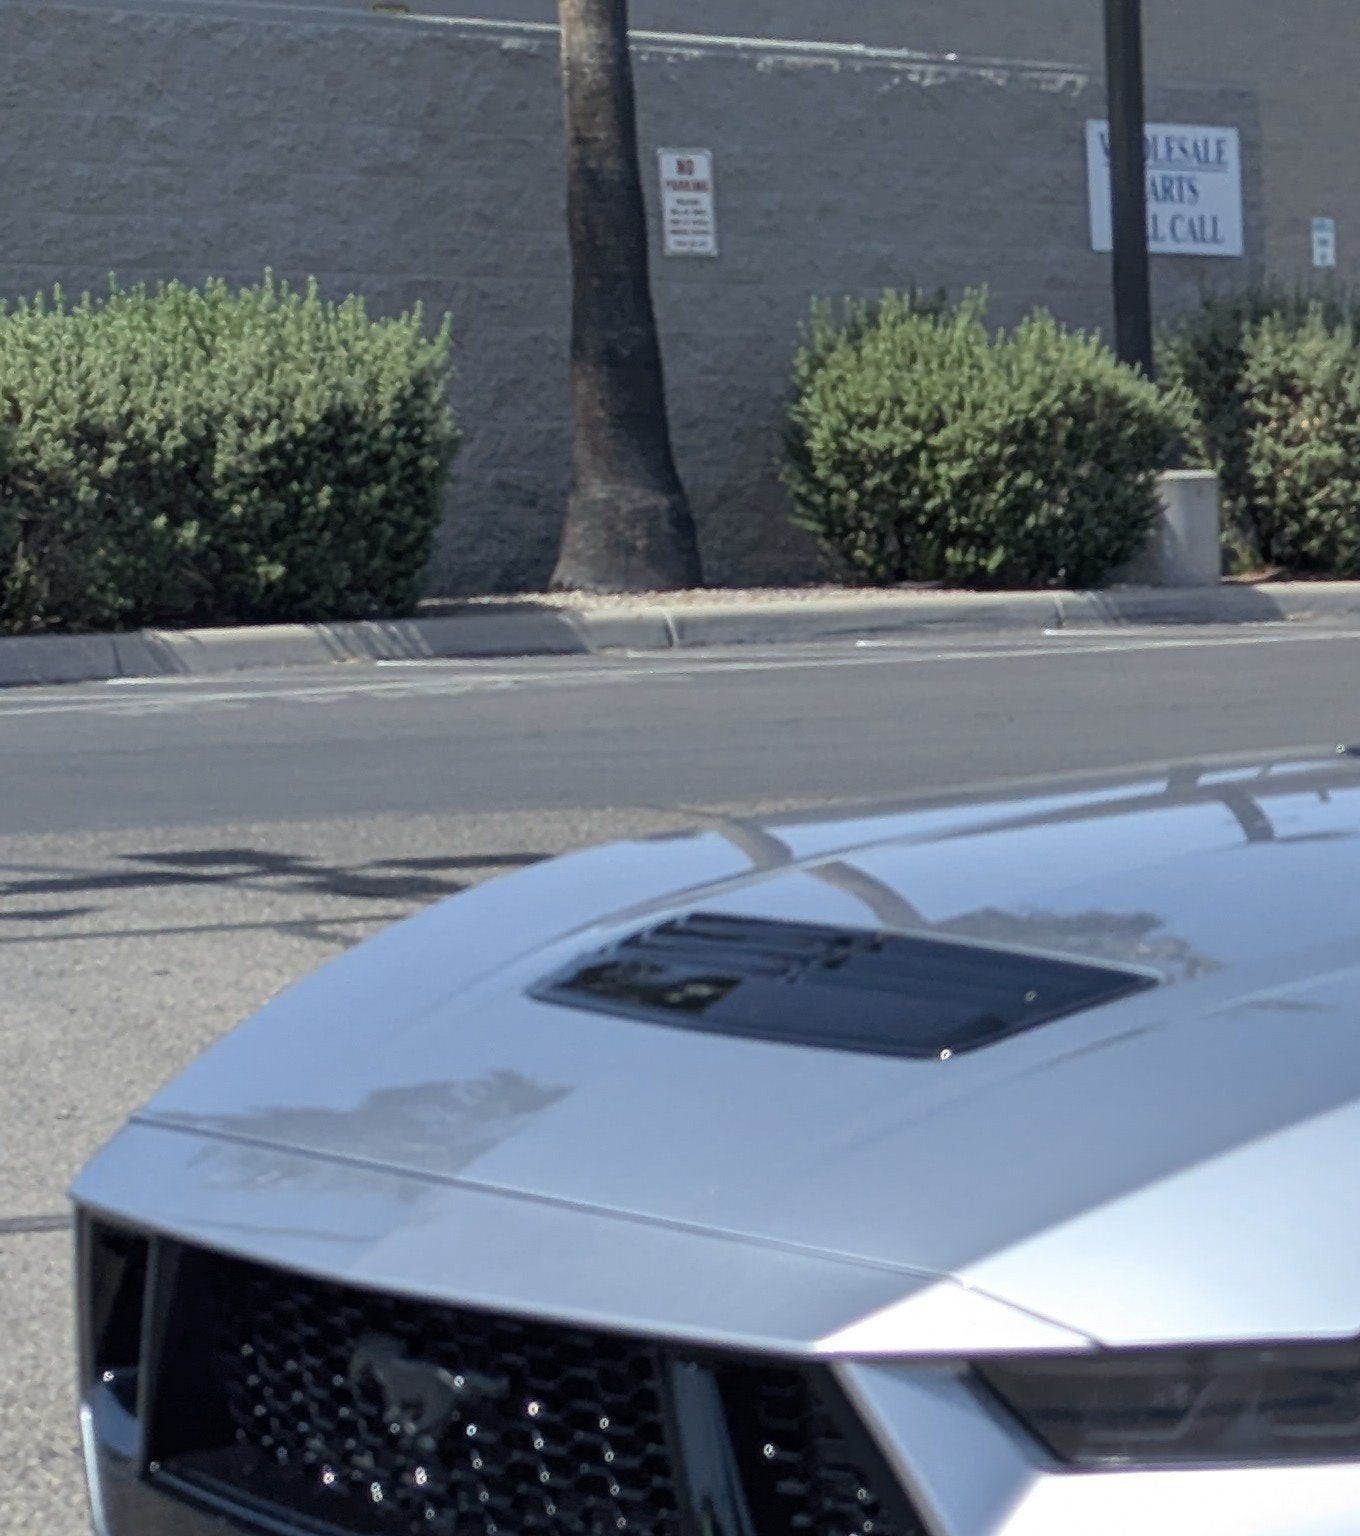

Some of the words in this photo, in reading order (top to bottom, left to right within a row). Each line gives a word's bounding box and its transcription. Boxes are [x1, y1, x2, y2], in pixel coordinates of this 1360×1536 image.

[1097, 131, 1228, 165] LESALE
[1147, 174, 1199, 204] ARTS
[1169, 214, 1226, 244] CALL
